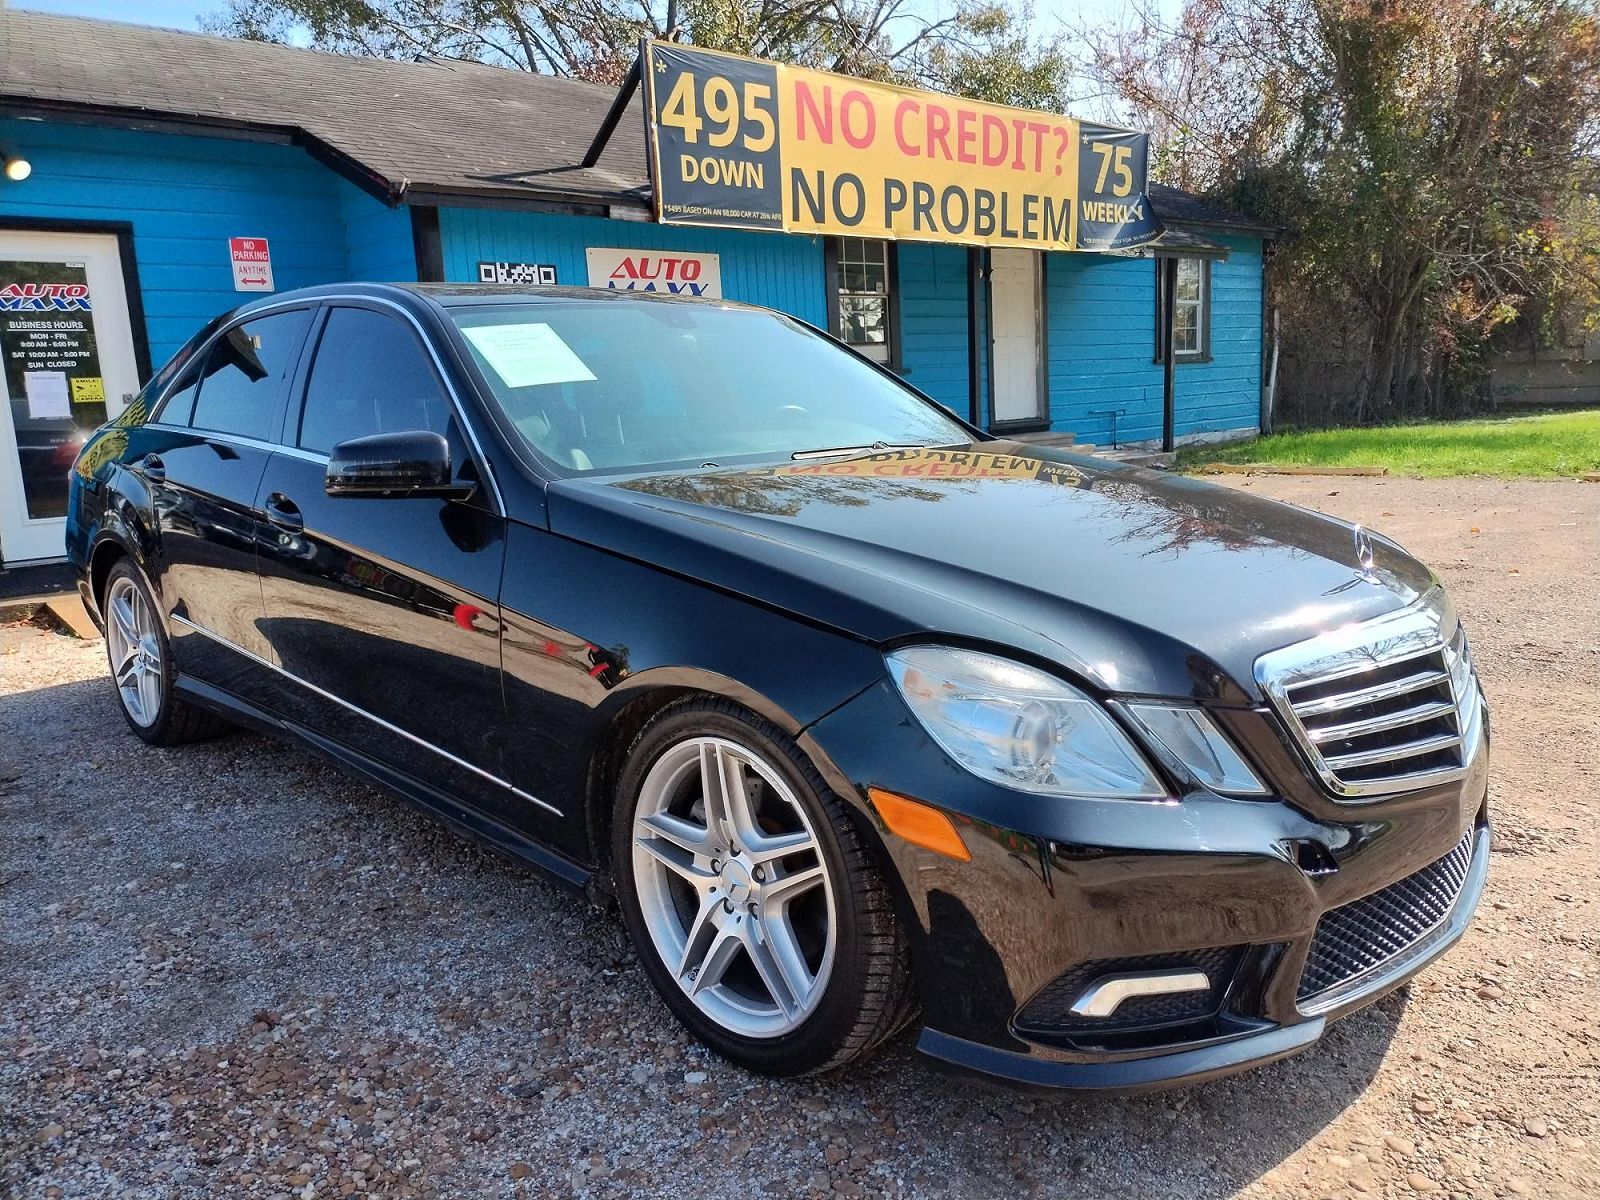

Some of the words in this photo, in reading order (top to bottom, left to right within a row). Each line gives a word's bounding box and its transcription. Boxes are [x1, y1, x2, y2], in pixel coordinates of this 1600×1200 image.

[795, 80, 876, 149] NO
[894, 100, 1069, 176] CREDIT?
[681, 154, 764, 189] DOWN
[682, 205, 702, 214] BASED
[702, 207, 712, 216] ON
[713, 208, 722, 216] AN
[740, 210, 752, 218] CAR
[752, 211, 760, 219] AT
[791, 167, 866, 226] NO
[884, 178, 1071, 242] PROBLEM
[1082, 200, 1145, 224] WEEKLY
[243, 241, 255, 250] NO
[233, 250, 268, 260] PARKING
[238, 265, 267, 275] ANYTIME
[609, 257, 702, 280] AUTO
[0, 283, 89, 298] AUTO
[9, 321, 52, 329] BUSINESS
[54, 321, 84, 329] HOURS
